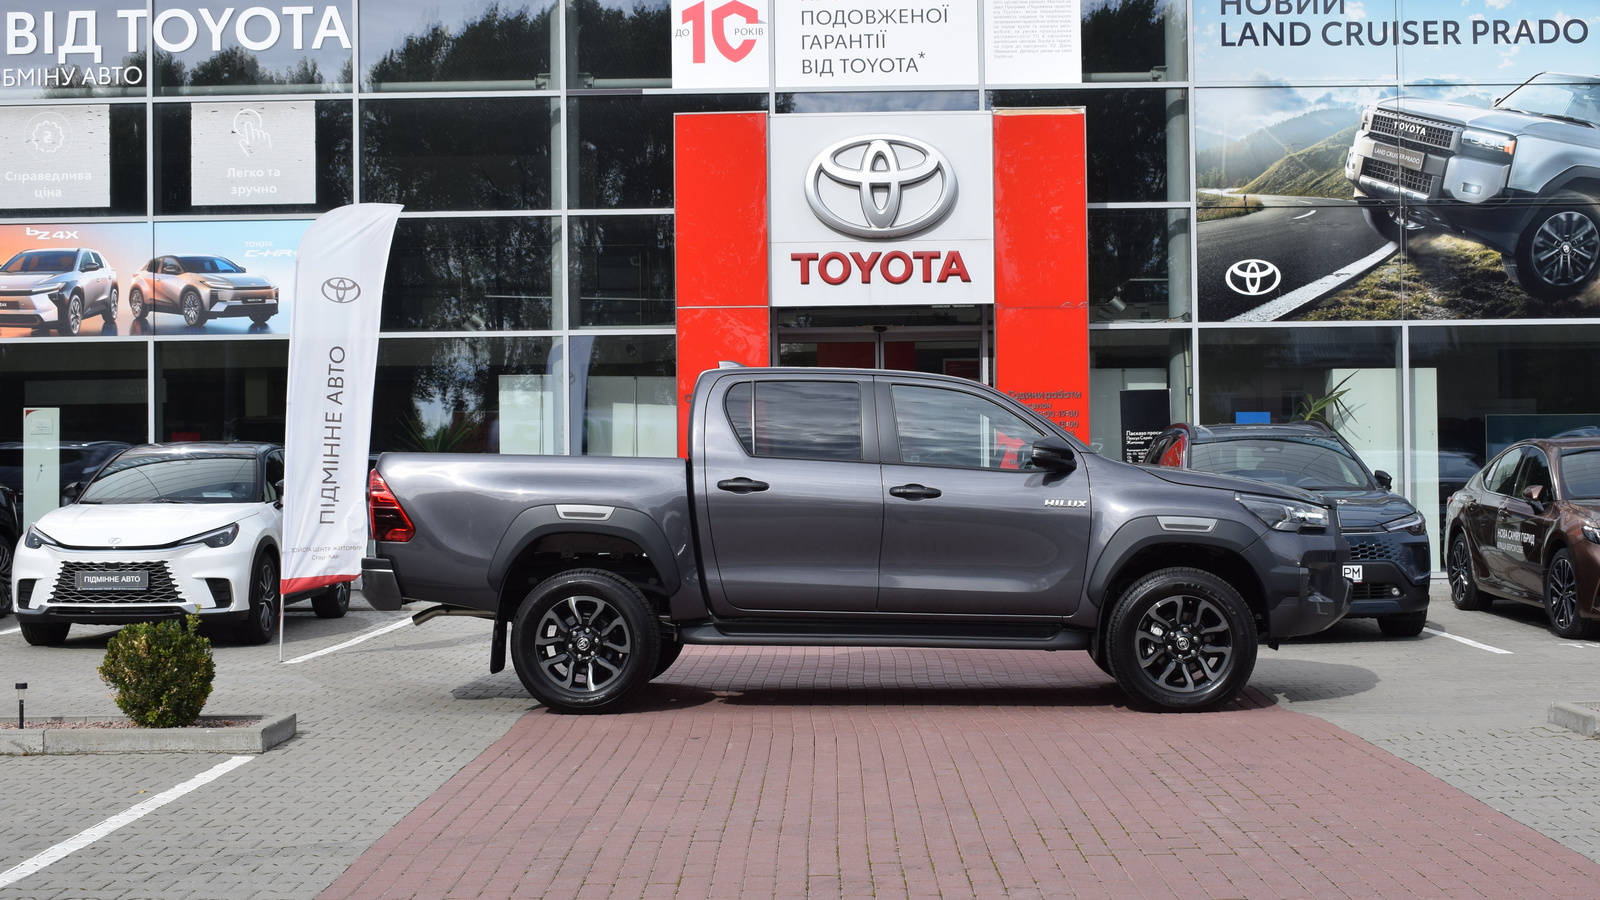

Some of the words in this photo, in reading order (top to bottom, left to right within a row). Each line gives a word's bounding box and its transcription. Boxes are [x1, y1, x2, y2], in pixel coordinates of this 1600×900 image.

[801, 4, 950, 28] ПОДОВЖЕНОЇ
[6, 10, 102, 64] ВІД
[117, 5, 352, 54] TOYOTA
[674, 28, 690, 38] ДО
[734, 28, 764, 36] РОКІВ
[802, 30, 887, 50] ГАРАНТІЇ
[1221, 22, 1311, 46] LAND
[1321, 20, 1462, 46] CRUISER
[1472, 18, 1589, 44] PRADO
[802, 58, 834, 77] ВІД
[3, 66, 76, 87] БМІНУ
[82, 66, 143, 85] АВТО
[1394, 122, 1426, 136] TOYOTA
[5, 171, 92, 183] Справедлива
[227, 168, 264, 178] Легко
[34, 186, 62, 199] ціна
[231, 186, 277, 197] зручно
[790, 250, 972, 286] TOYOTA
[326, 346, 346, 405] АВТО
[1008, 390, 1044, 400] Години
[1045, 390, 1081, 400] роботи
[319, 412, 343, 524] ПІДМІННЕ
[1044, 499, 1087, 507] HILUX
